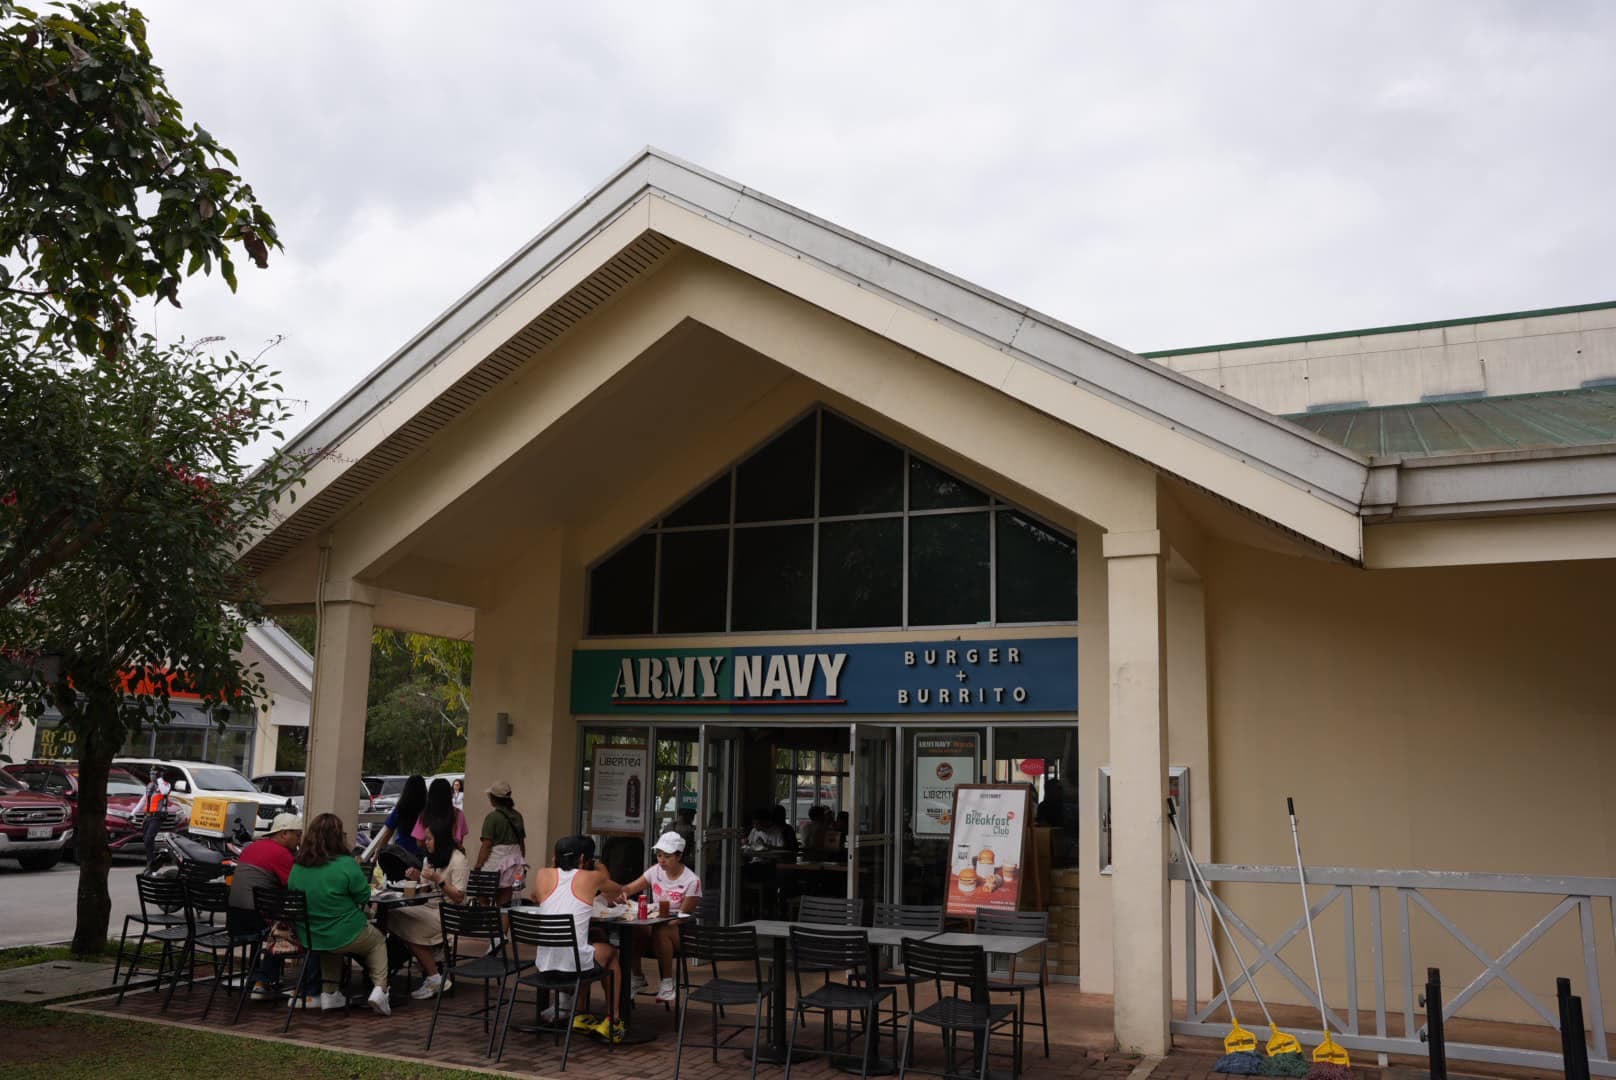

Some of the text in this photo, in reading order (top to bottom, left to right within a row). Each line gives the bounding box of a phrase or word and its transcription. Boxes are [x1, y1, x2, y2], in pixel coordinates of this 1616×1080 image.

[904, 648, 1020, 665] BURGER
[611, 653, 847, 698] ARMY NAVY
[898, 687, 1026, 704] BURRITO
[923, 790, 955, 801] LIBERT
[965, 813, 1010, 826] Breakfast
[992, 825, 1010, 835] Club
